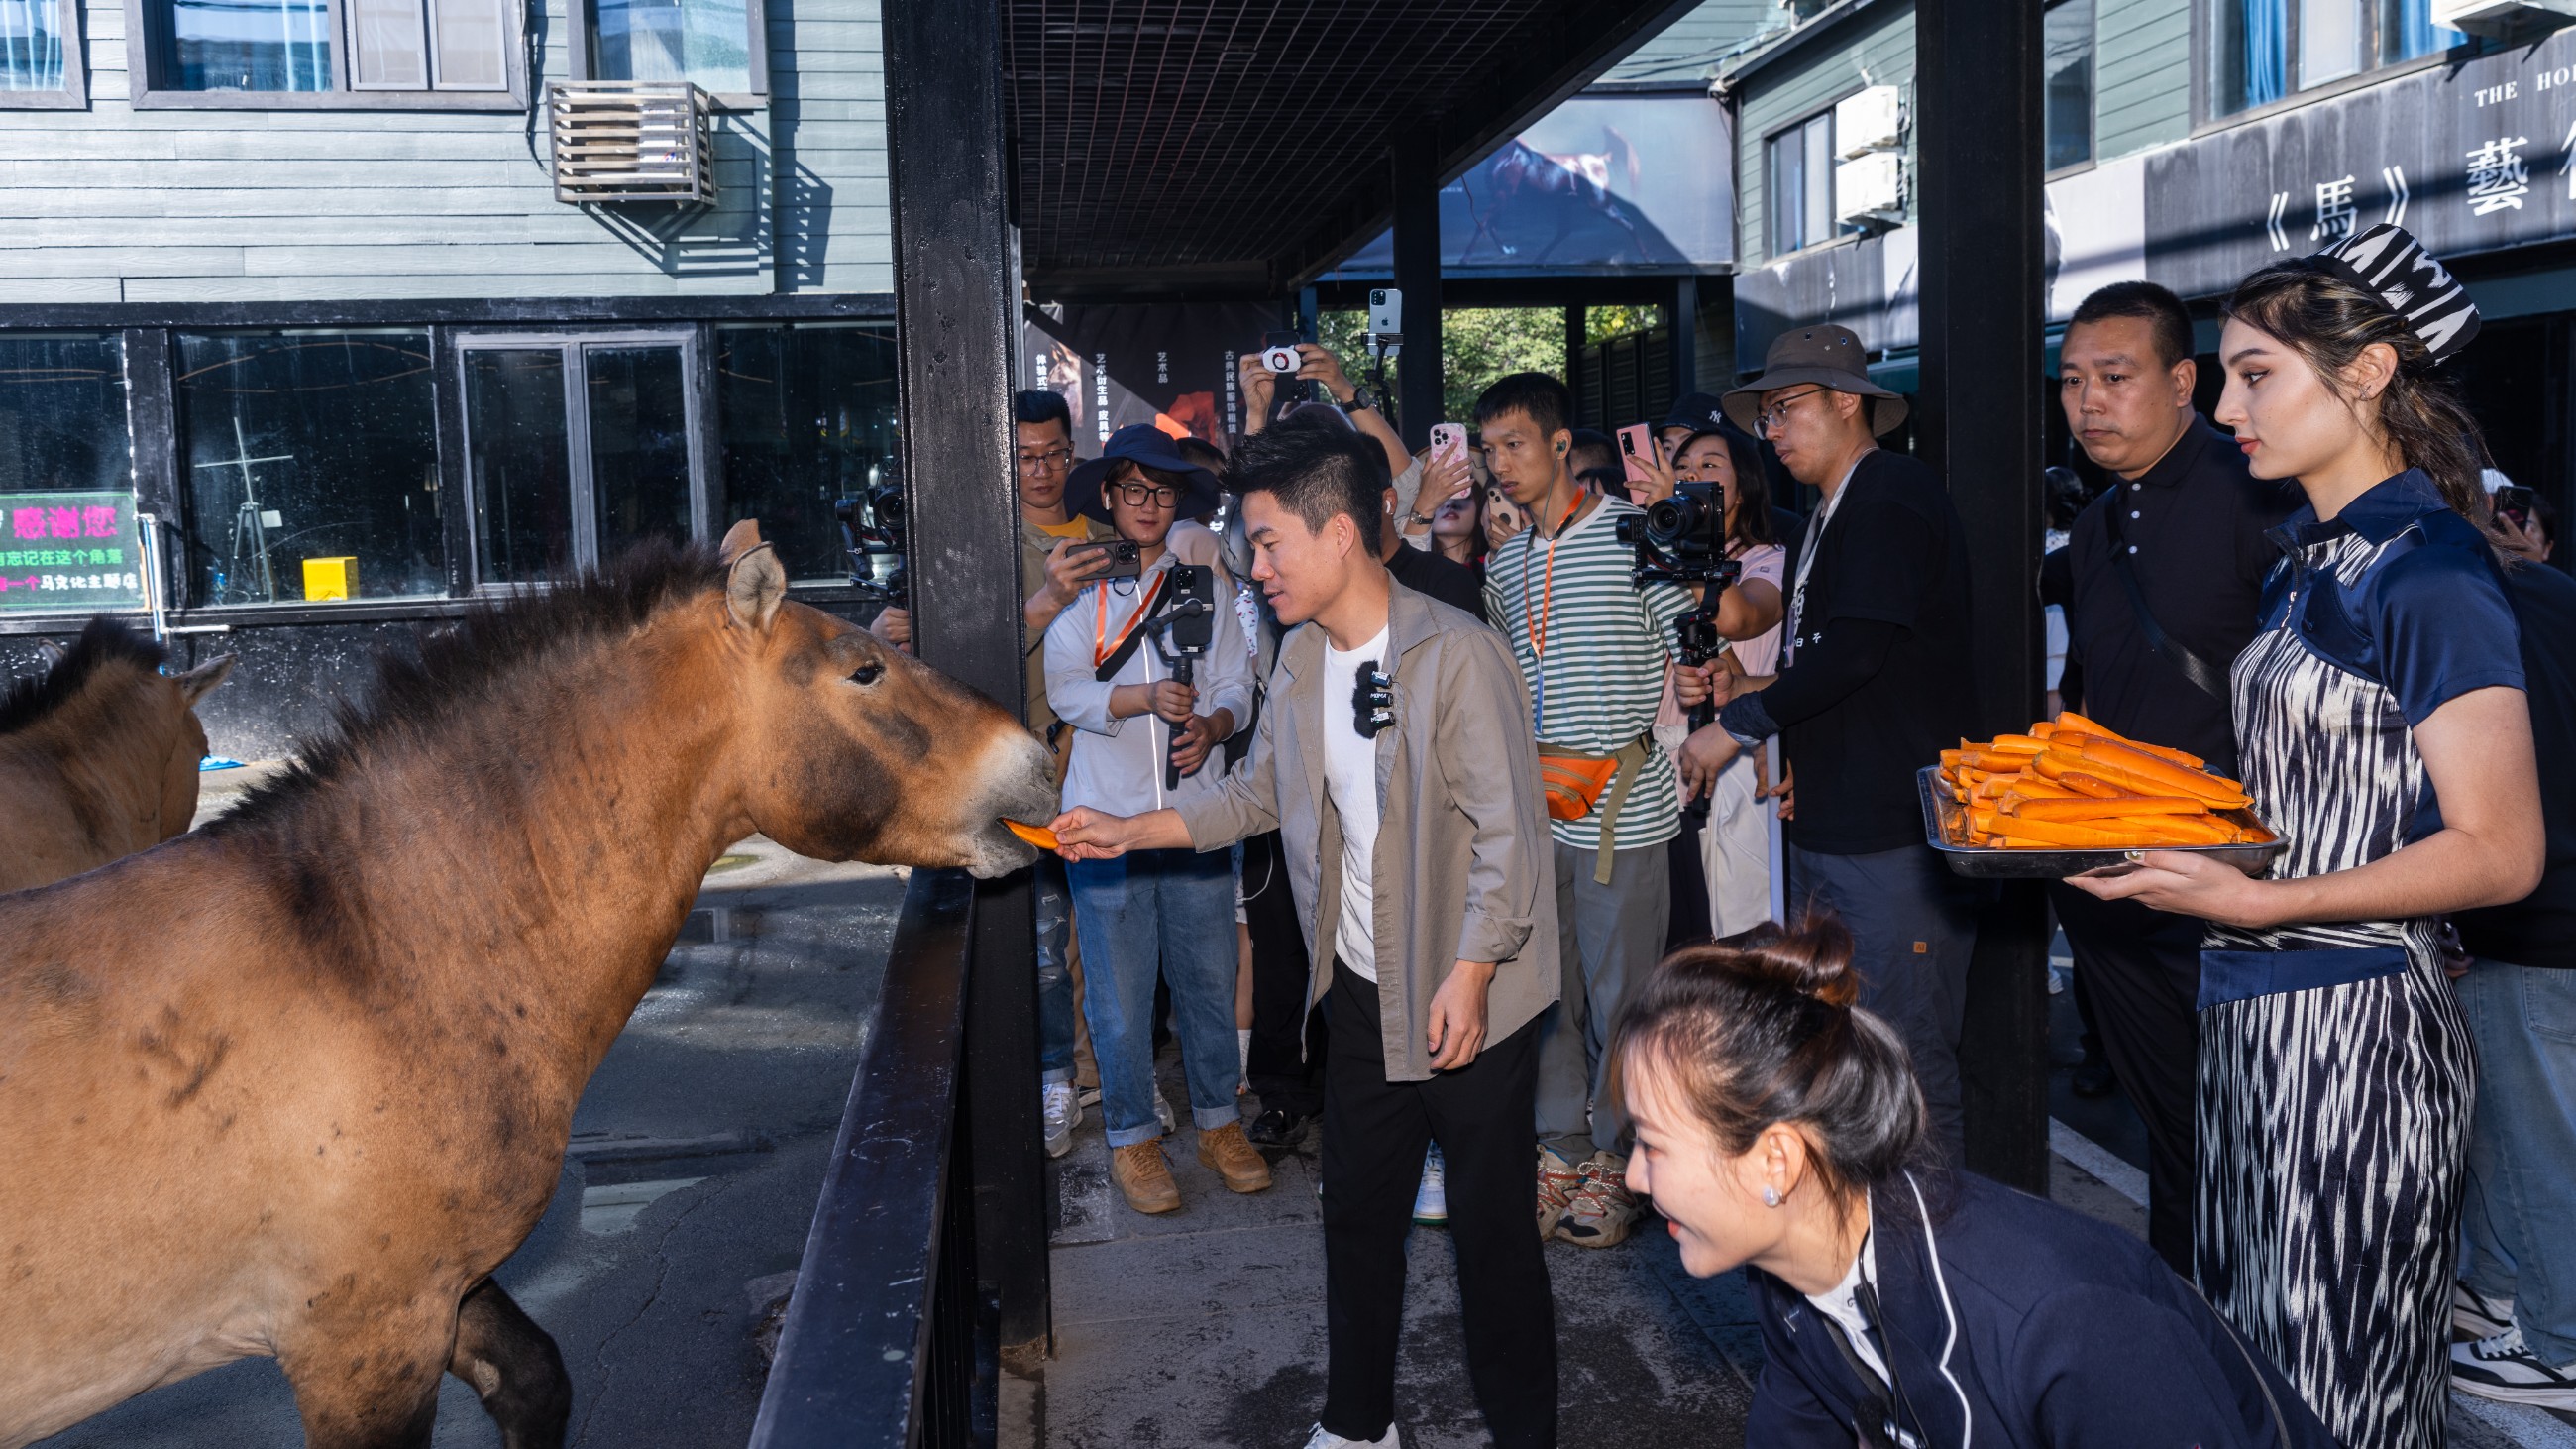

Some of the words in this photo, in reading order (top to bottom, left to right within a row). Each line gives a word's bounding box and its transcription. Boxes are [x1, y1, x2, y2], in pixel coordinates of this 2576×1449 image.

[2474, 81, 2518, 108] THE
[1095, 353, 1109, 407] 艺术衍生品
[1157, 351, 1168, 384] 艺术品
[0, 549, 123, 566] 忘记在这个角落
